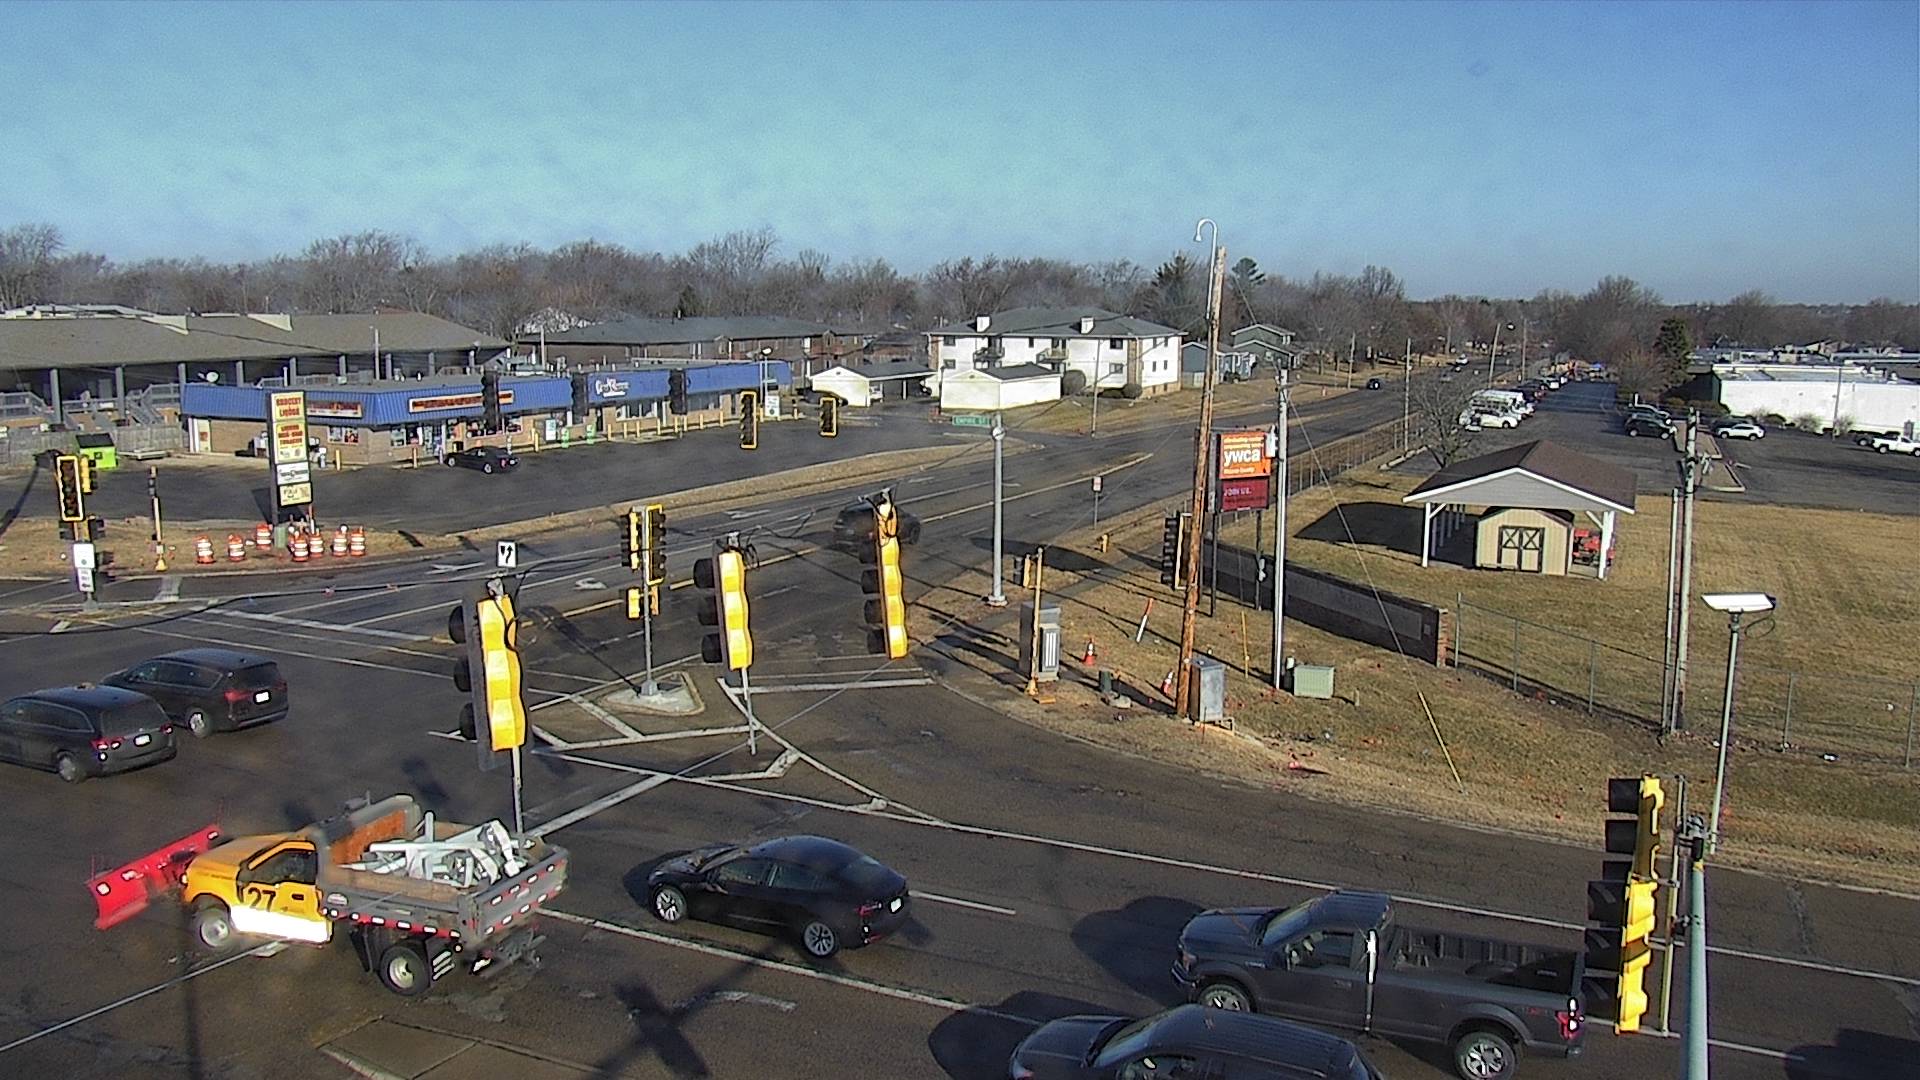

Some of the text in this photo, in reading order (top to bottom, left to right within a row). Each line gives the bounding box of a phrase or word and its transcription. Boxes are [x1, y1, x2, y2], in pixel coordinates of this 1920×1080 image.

[1224, 449, 1261, 467] ywca
[1224, 487, 1240, 496] JOIN
[248, 887, 276, 912] 27
